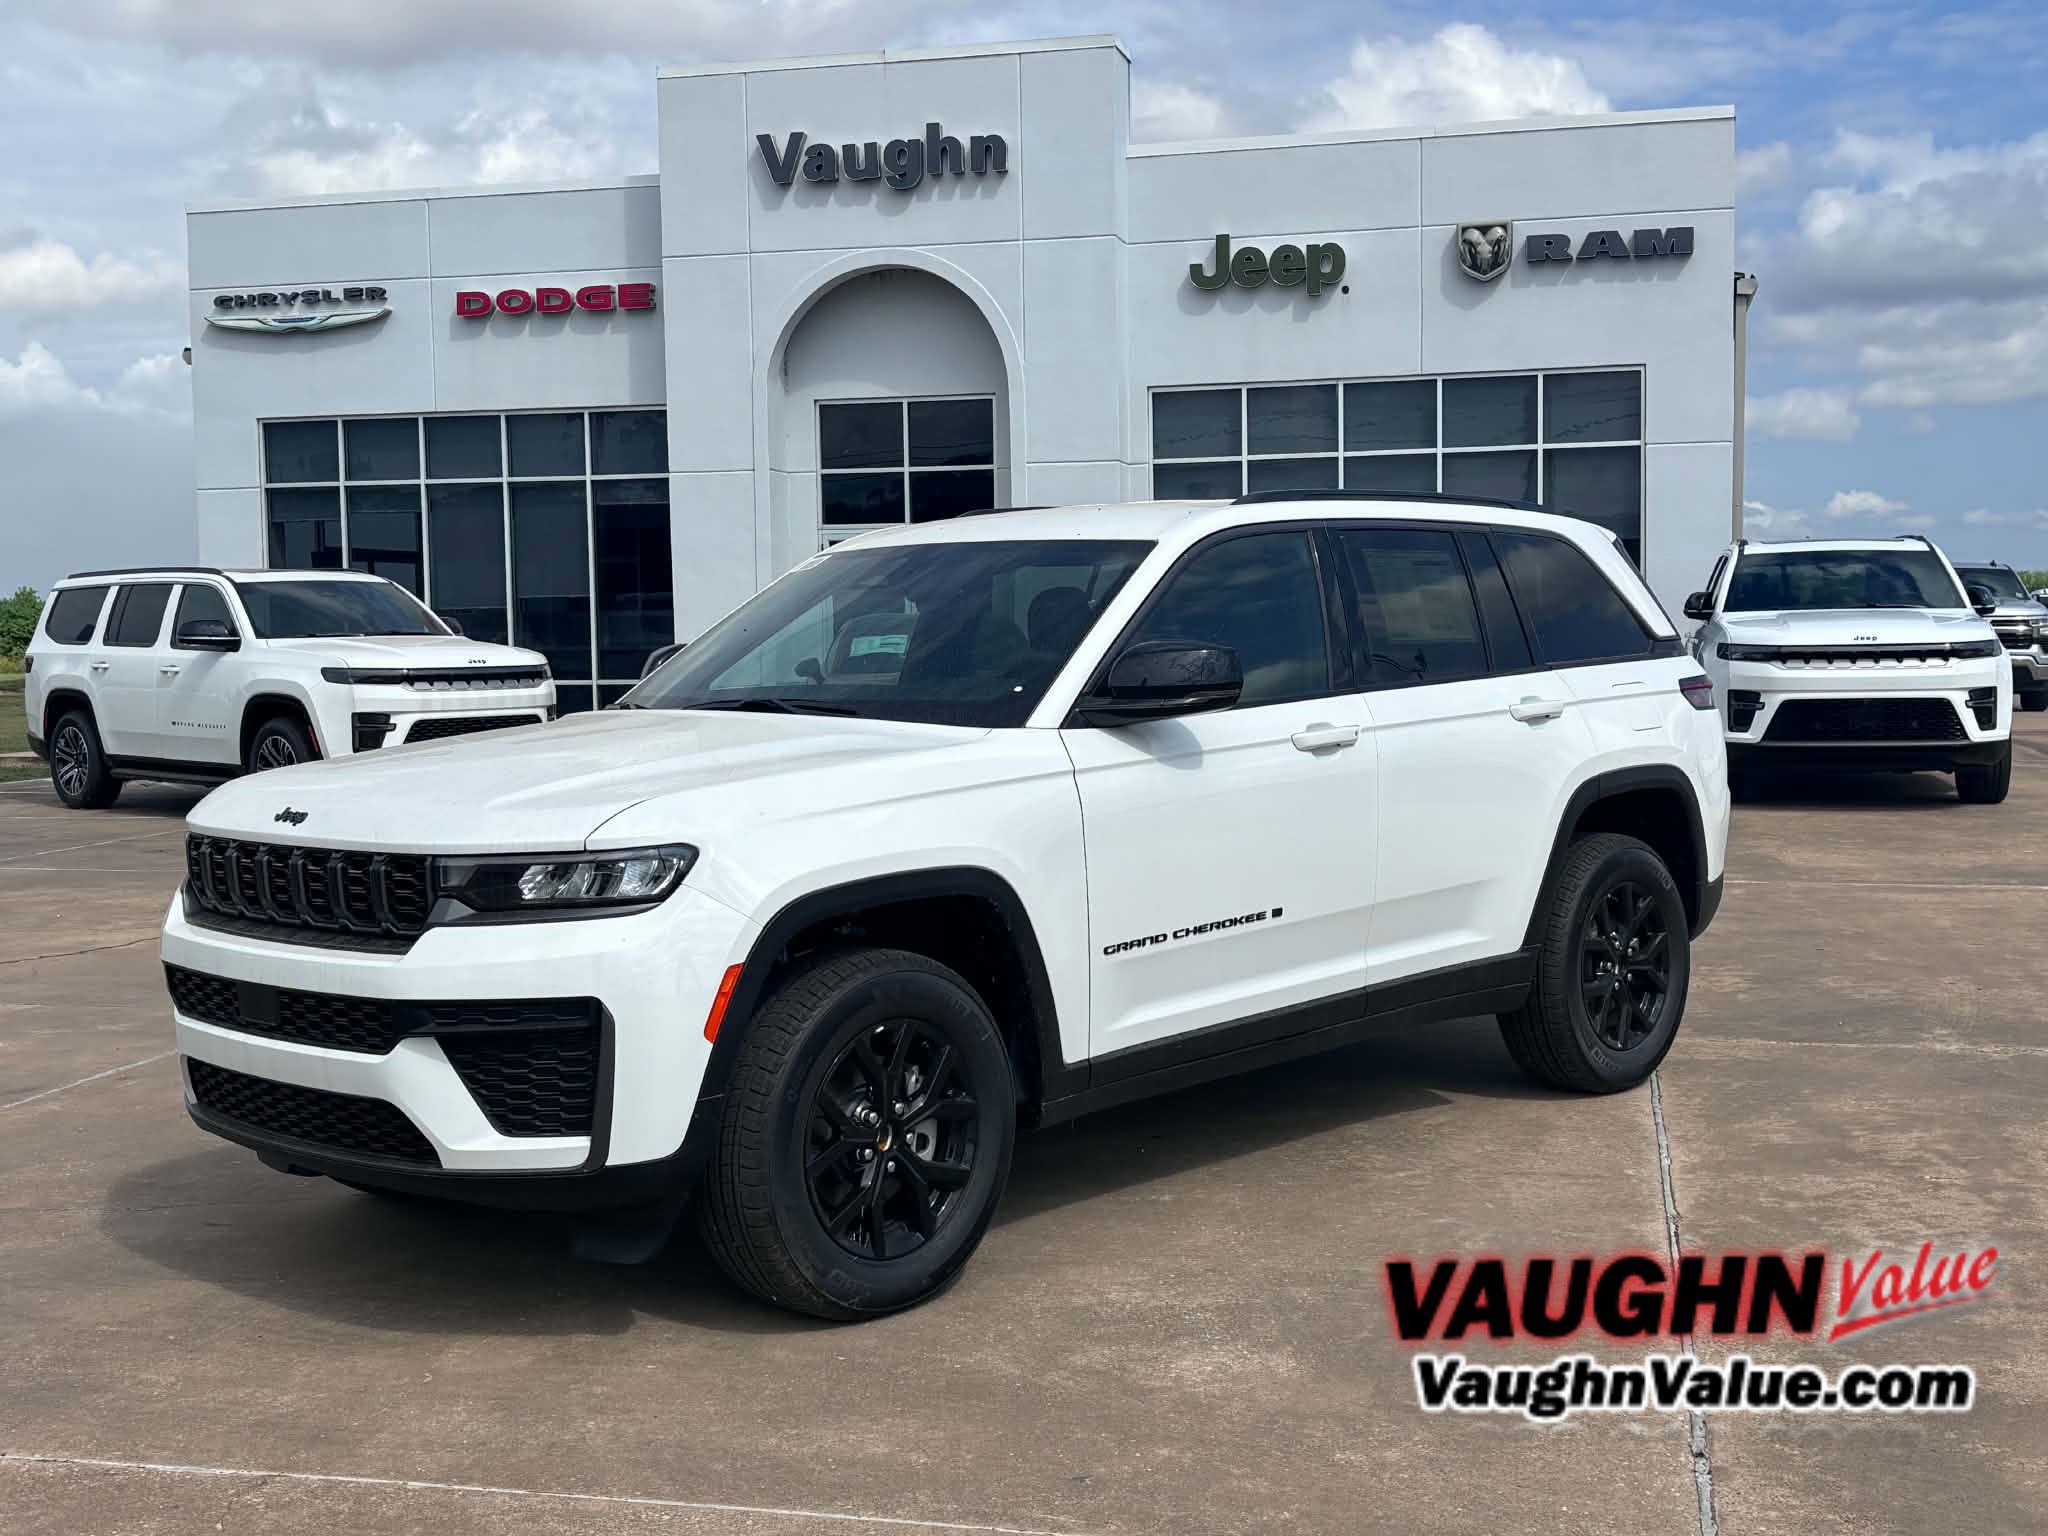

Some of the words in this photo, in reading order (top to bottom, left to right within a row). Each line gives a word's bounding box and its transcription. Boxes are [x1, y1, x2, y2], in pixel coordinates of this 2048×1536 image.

[756, 122, 1008, 190] Vaughn
[1526, 226, 1694, 263] RAM
[1189, 234, 1346, 296] Jeep
[213, 286, 388, 309] CHRYSLER
[456, 283, 656, 317] DODGE
[274, 806, 309, 827] Jeep
[1103, 932, 1168, 956] GRAND
[1172, 906, 1268, 941] CHEROKEE
